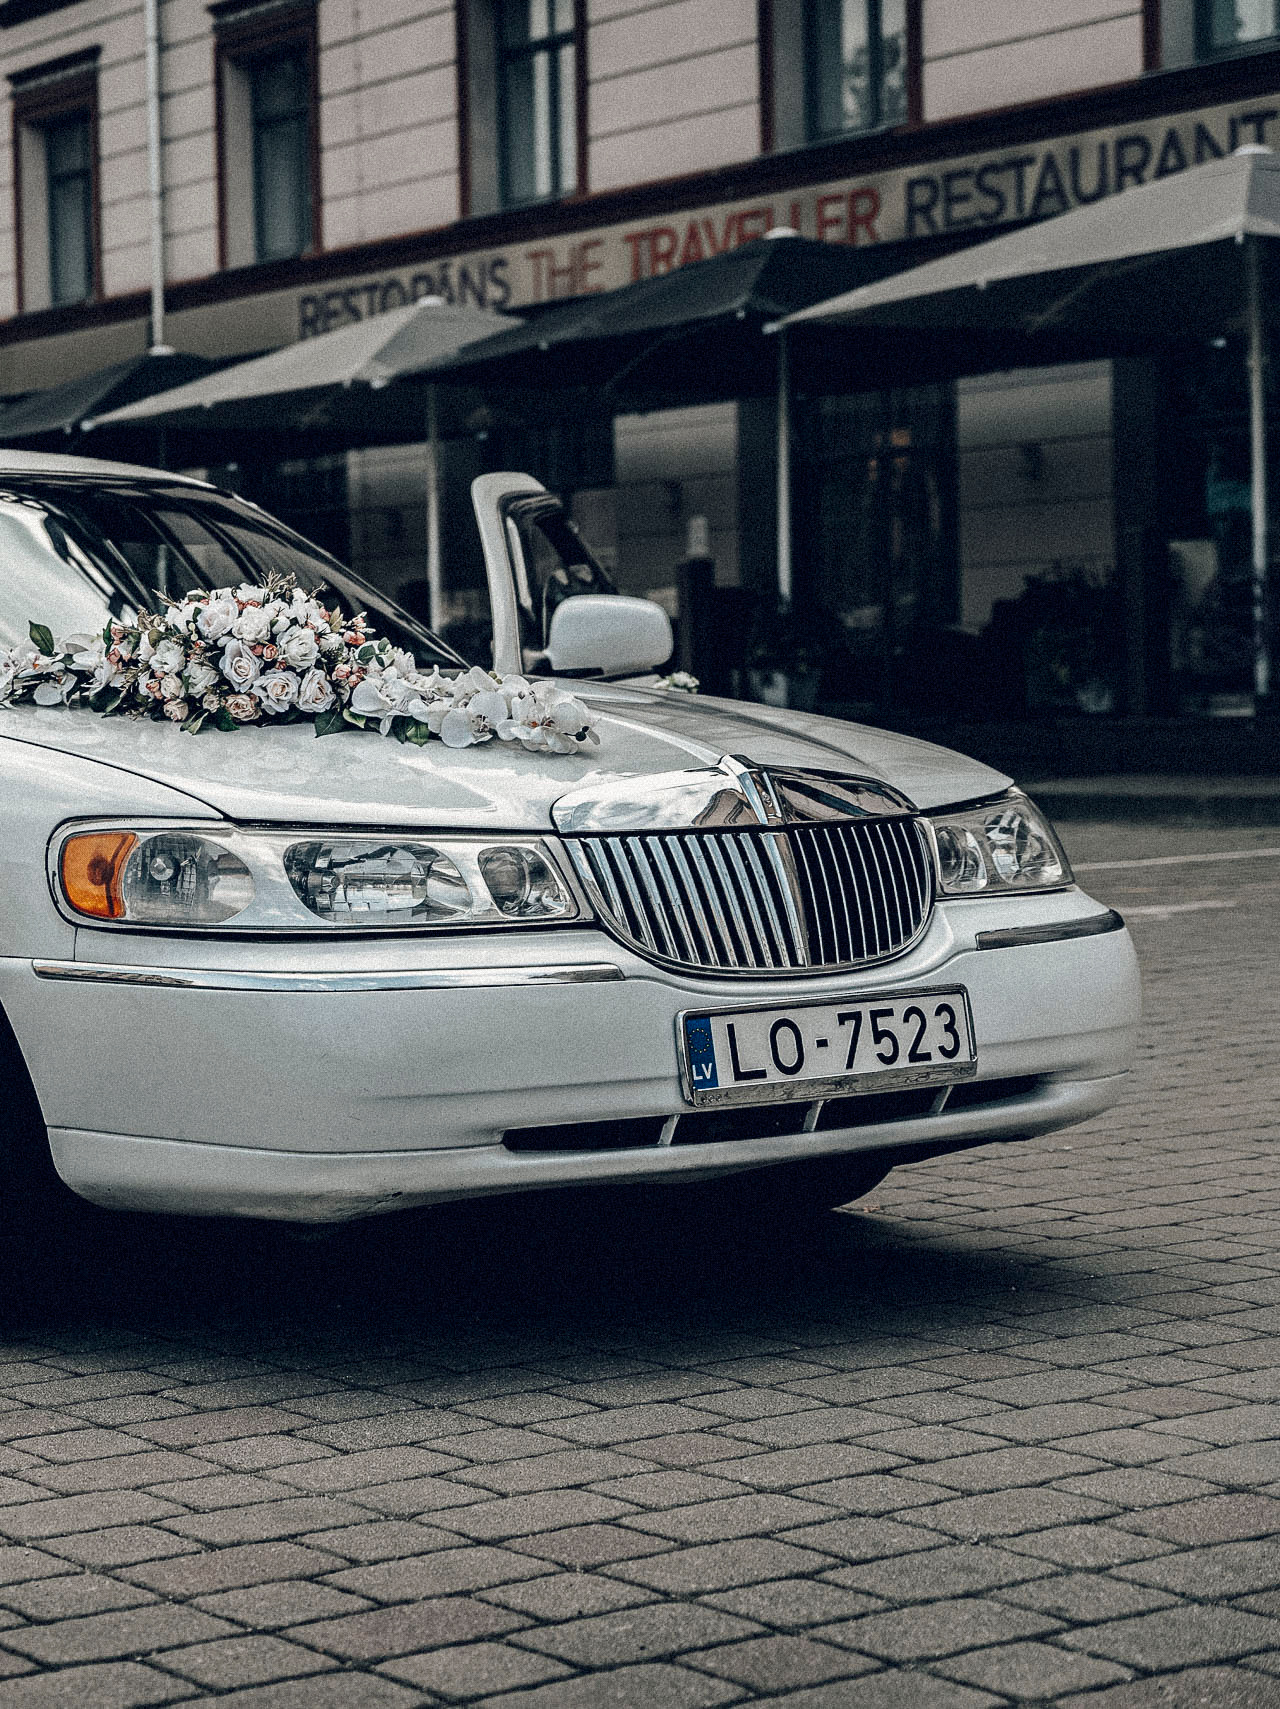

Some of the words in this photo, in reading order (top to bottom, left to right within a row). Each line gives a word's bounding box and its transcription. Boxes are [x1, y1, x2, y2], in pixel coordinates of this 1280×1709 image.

[526, 239, 605, 300] THE
[692, 1062, 713, 1081] LV
[726, 1003, 961, 1082] LO-7523
